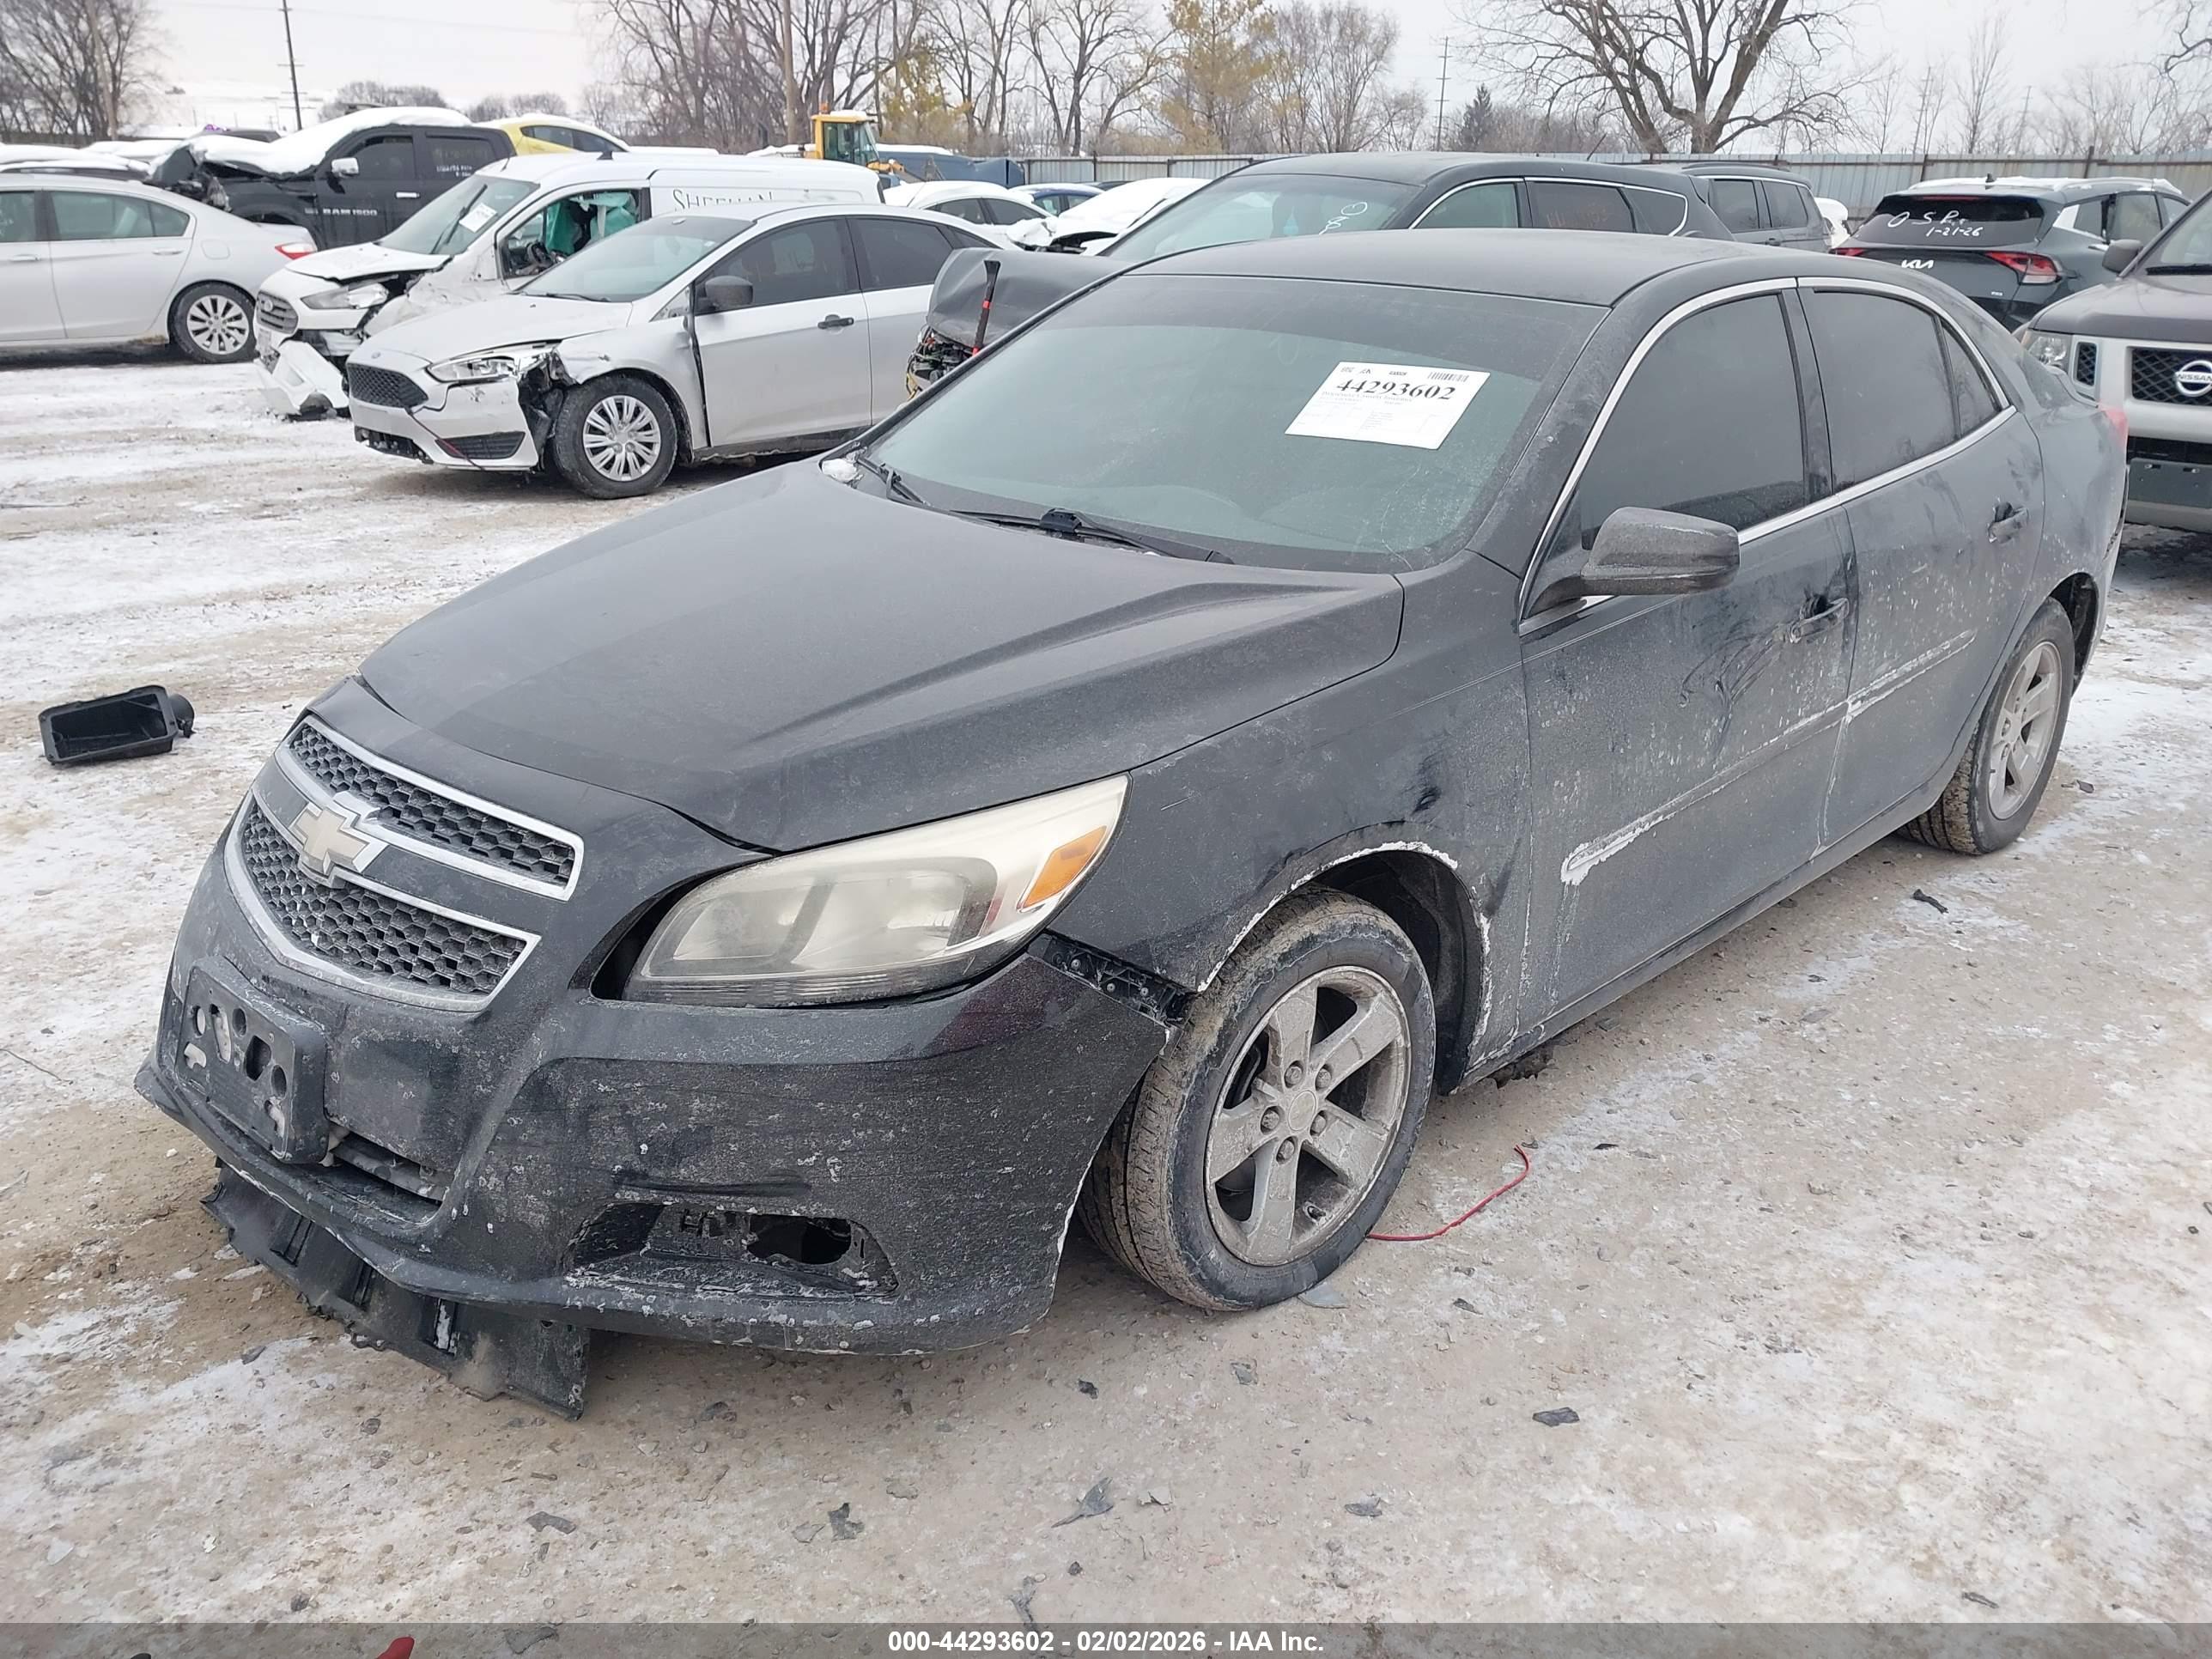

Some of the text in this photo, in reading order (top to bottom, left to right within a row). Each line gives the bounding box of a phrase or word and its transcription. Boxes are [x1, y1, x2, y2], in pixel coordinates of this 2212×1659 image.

[672, 188, 773, 212] SHEN
[1925, 226, 1984, 238] 1-21-26
[1337, 379, 1456, 400] 44293602
